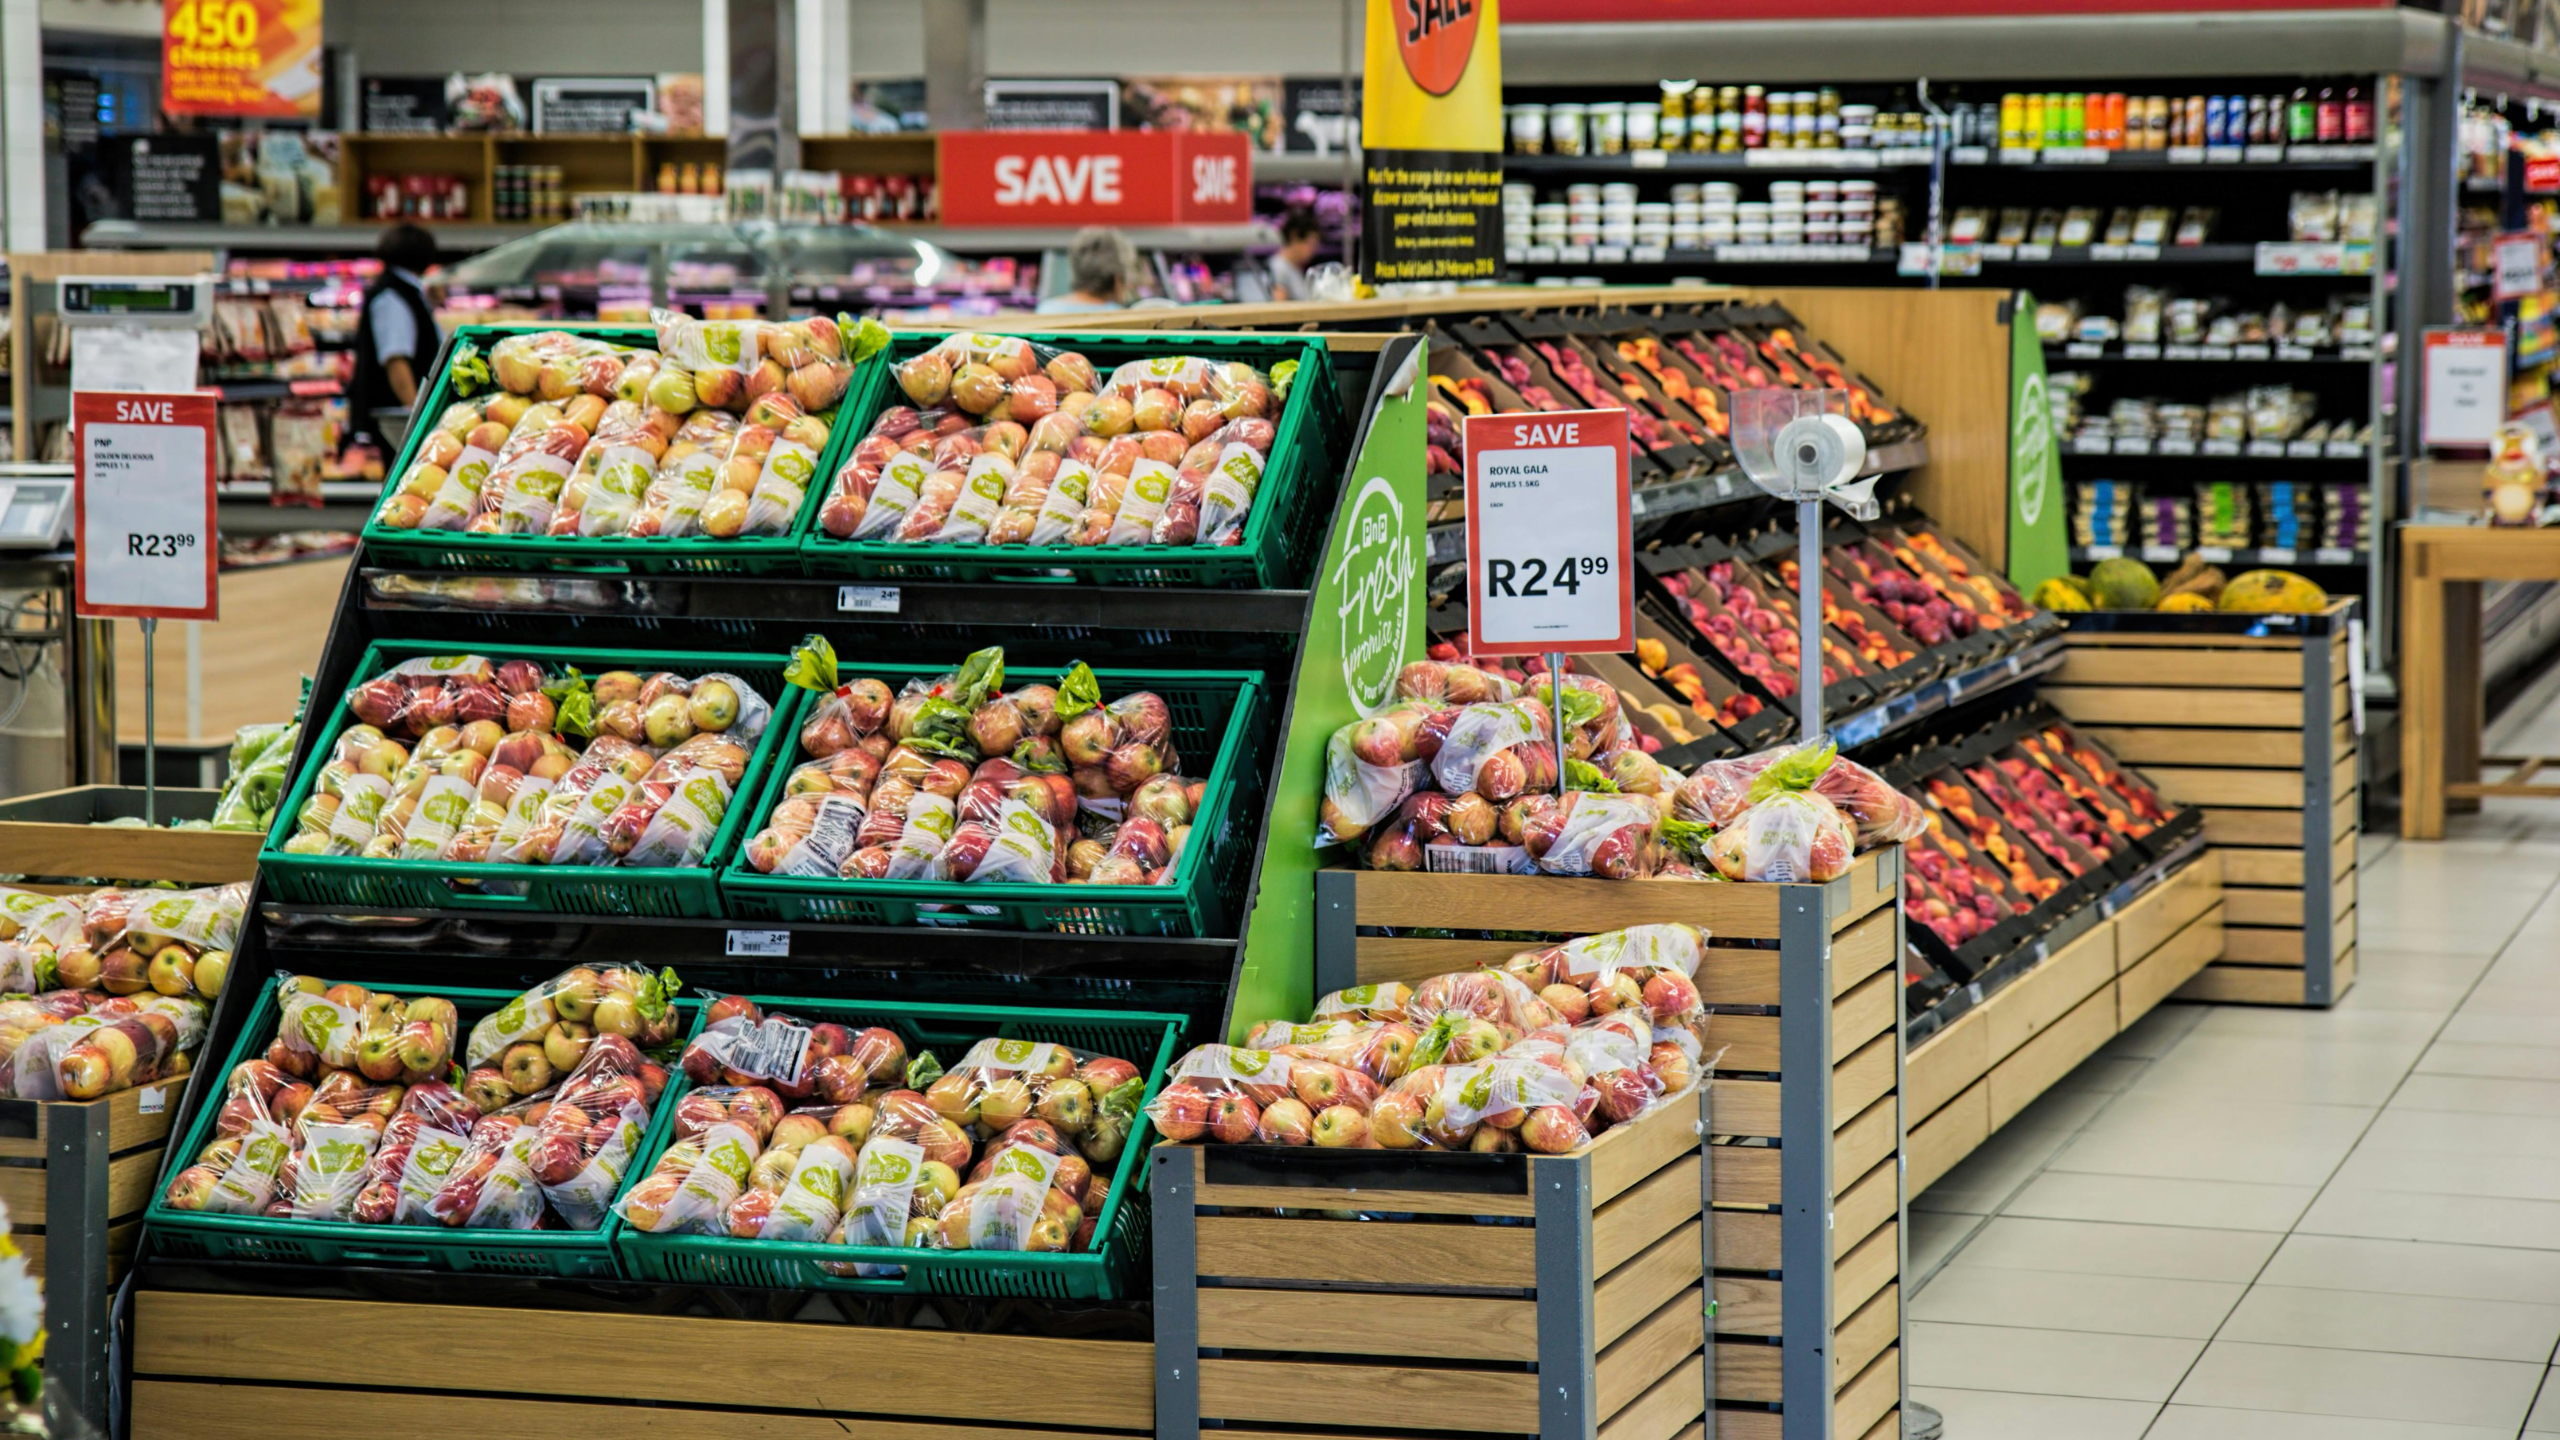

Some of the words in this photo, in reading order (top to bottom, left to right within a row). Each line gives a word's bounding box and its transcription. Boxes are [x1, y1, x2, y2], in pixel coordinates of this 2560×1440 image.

[169, 1, 258, 49] 450
[169, 45, 261, 69] cheeses
[994, 155, 1123, 205] SAVE
[1193, 155, 1236, 205] SAVE
[116, 400, 174, 423] SAVE
[94, 438, 112, 447] PNP
[1514, 423, 1580, 447] SAVE
[1489, 466, 1521, 476] ROYAL
[1523, 464, 1549, 475] GALA
[1489, 480, 1517, 489] APPLES
[1518, 480, 1540, 488] 1.5KG
[1333, 503, 1417, 635] Fresh
[1391, 606, 1403, 652] back
[1349, 620, 1393, 697] promise
[867, 1172, 895, 1181] PPLES
[884, 1163, 908, 1174] GALA
